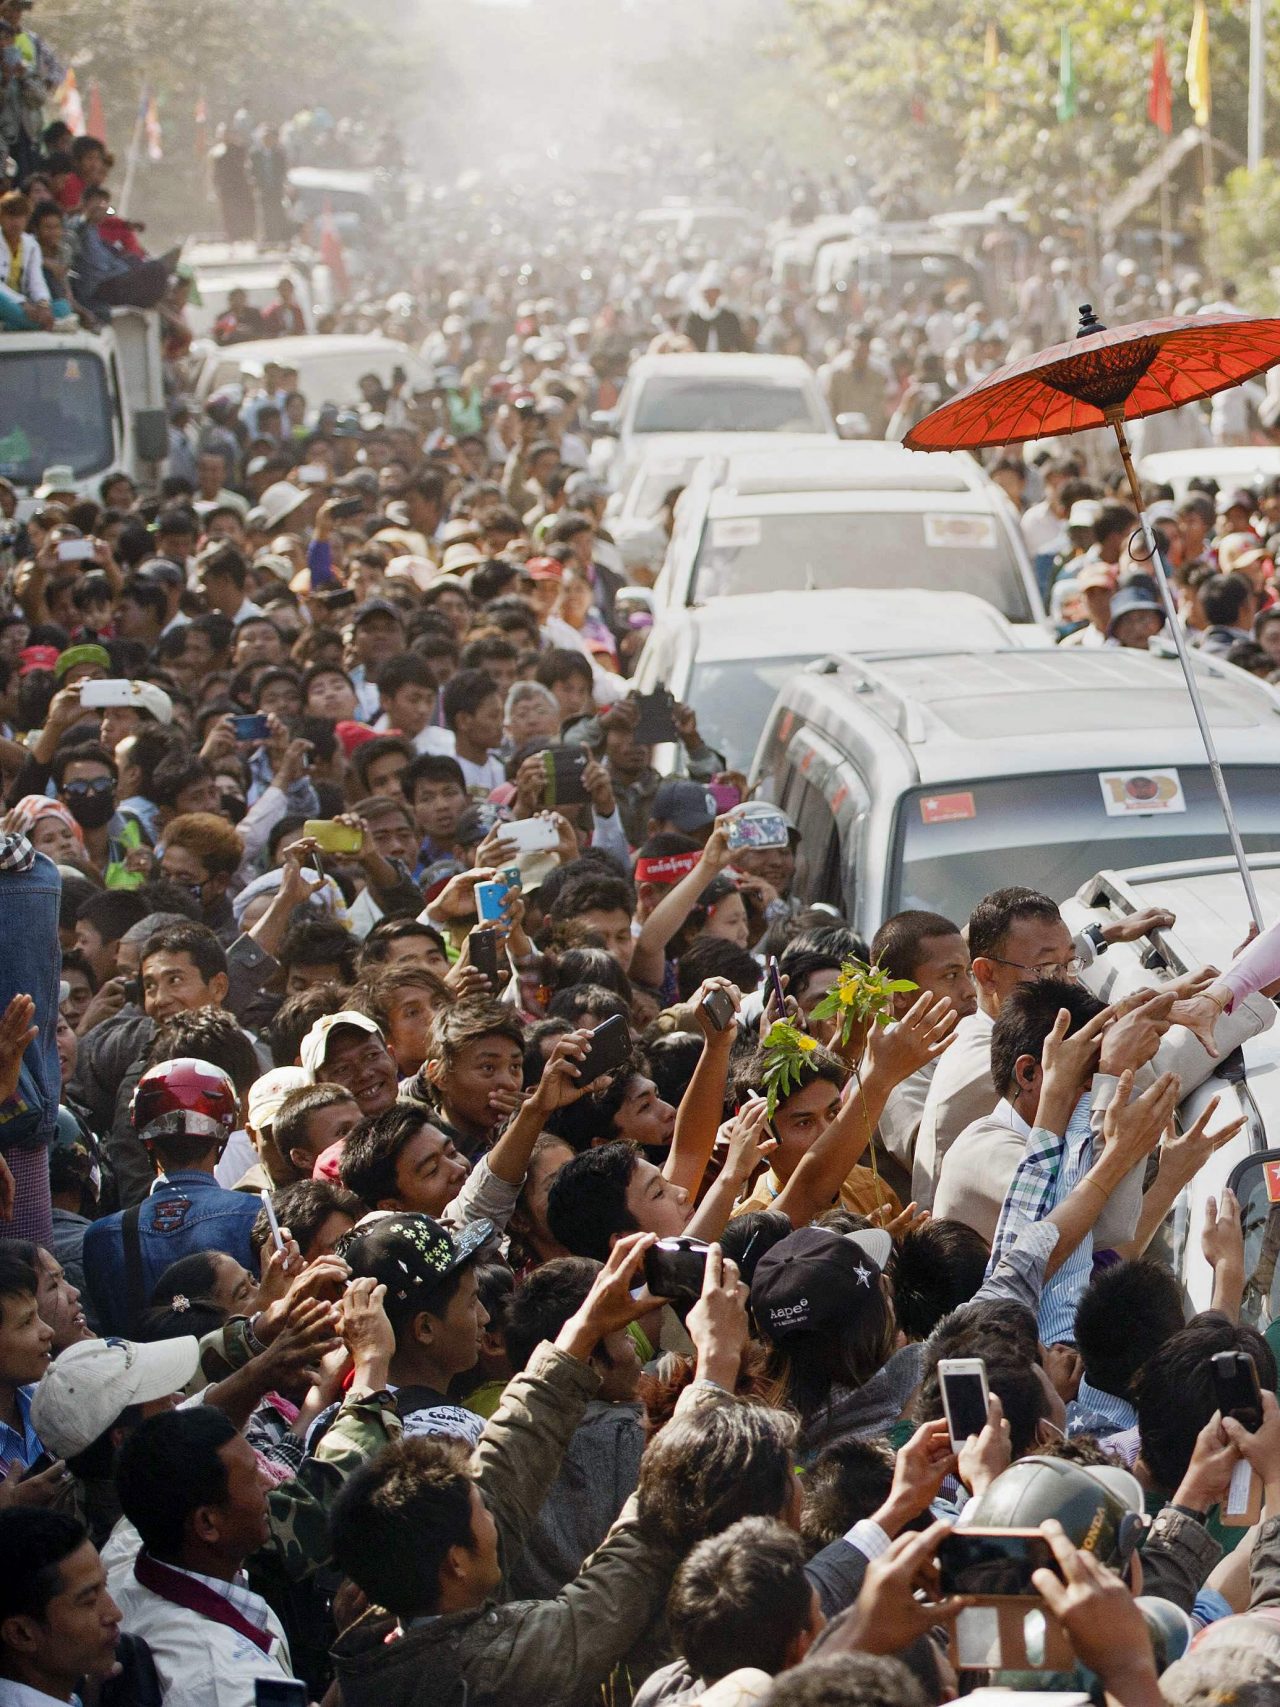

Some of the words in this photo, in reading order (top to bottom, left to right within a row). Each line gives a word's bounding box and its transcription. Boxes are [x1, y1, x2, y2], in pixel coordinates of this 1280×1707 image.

[769, 1304, 802, 1319] Aape
[428, 1411, 465, 1424] COME
[1083, 1507, 1105, 1550] ONDA
